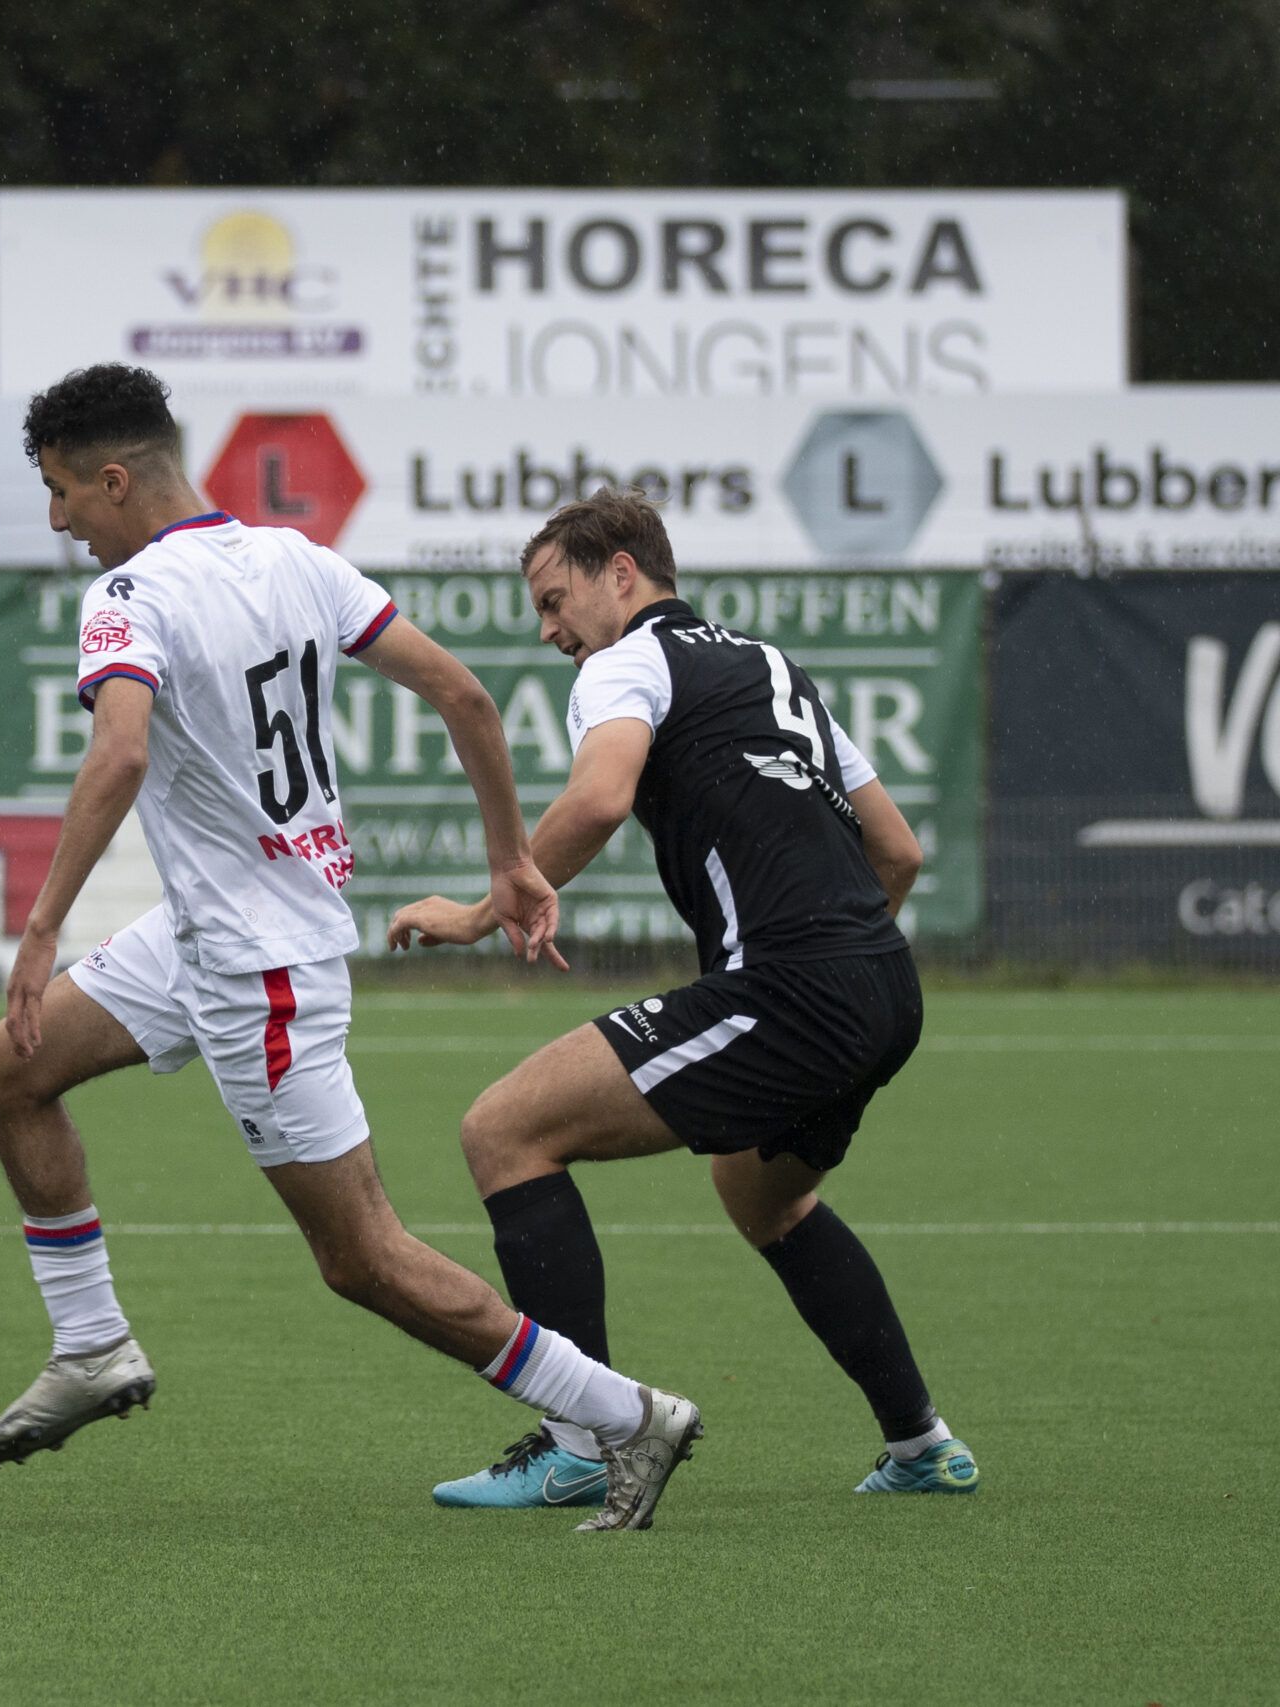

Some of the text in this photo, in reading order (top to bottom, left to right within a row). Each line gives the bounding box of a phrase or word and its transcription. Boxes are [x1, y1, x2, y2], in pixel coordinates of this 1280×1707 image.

[477, 217, 984, 294] HORECA
[264, 454, 311, 517] L
[410, 445, 756, 512] Lubbers
[841, 453, 883, 512] L
[244, 638, 337, 825] 51
[759, 643, 825, 772] 4
